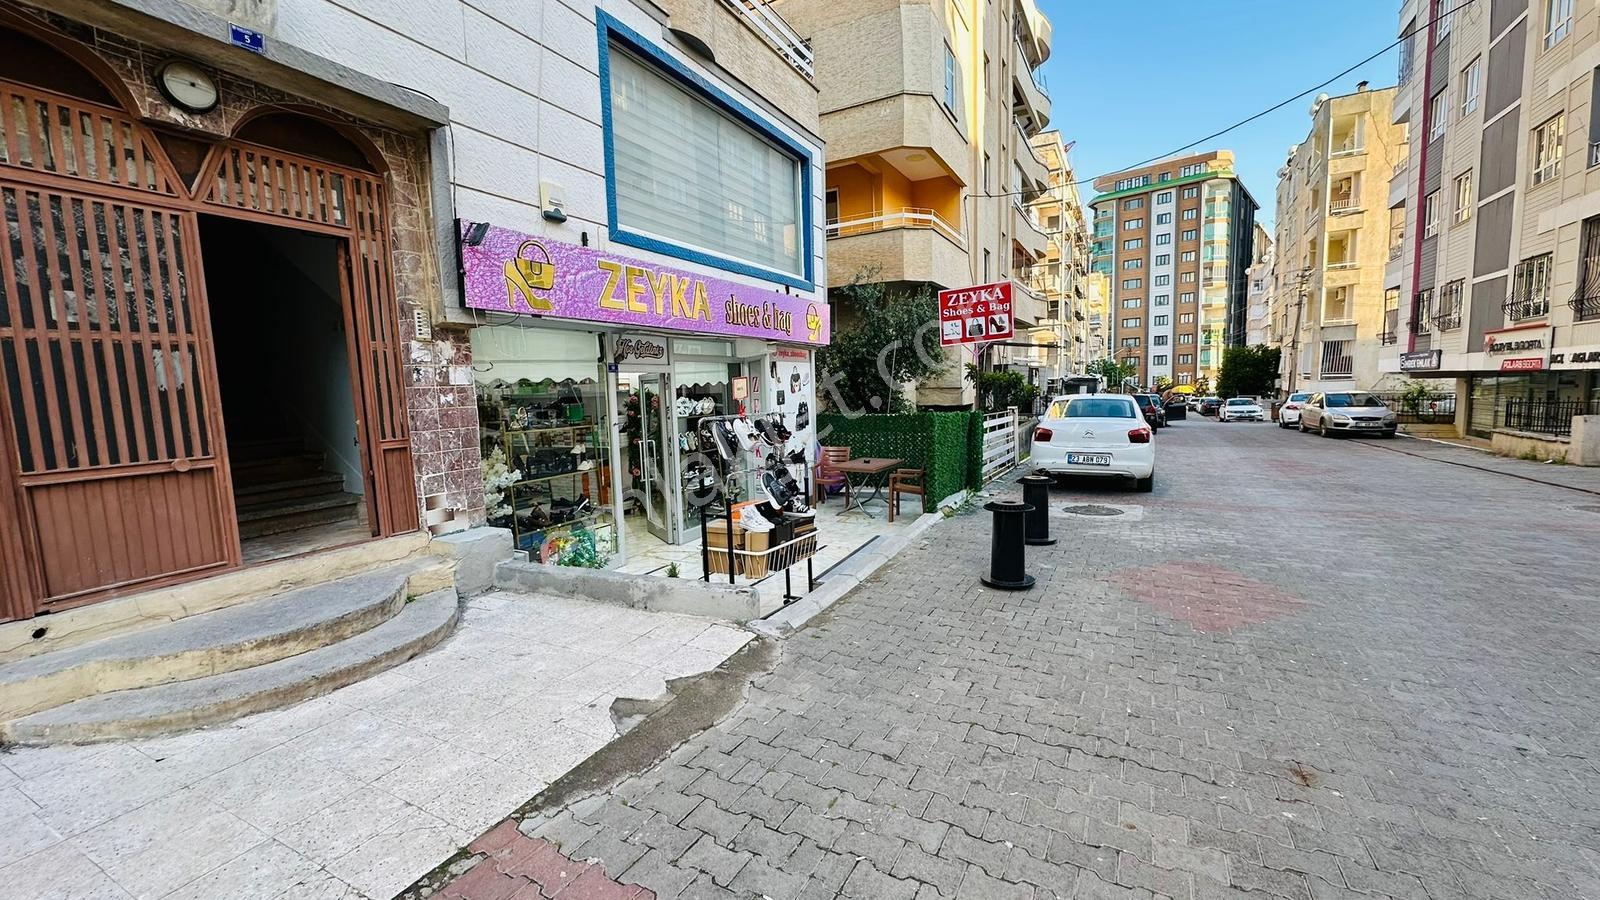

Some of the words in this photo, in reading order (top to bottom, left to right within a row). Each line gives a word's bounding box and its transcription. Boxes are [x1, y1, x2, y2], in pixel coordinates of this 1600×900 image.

[244, 34, 251, 44] 5
[597, 259, 712, 322] ZEYKA
[724, 293, 760, 328] shoes
[761, 300, 772, 330] &
[772, 302, 792, 335] bag
[947, 287, 1005, 307] ZEYKA
[942, 307, 974, 318] Shoes
[976, 304, 986, 313] &
[989, 302, 1010, 312] Bag
[1095, 456, 1108, 464] 079
